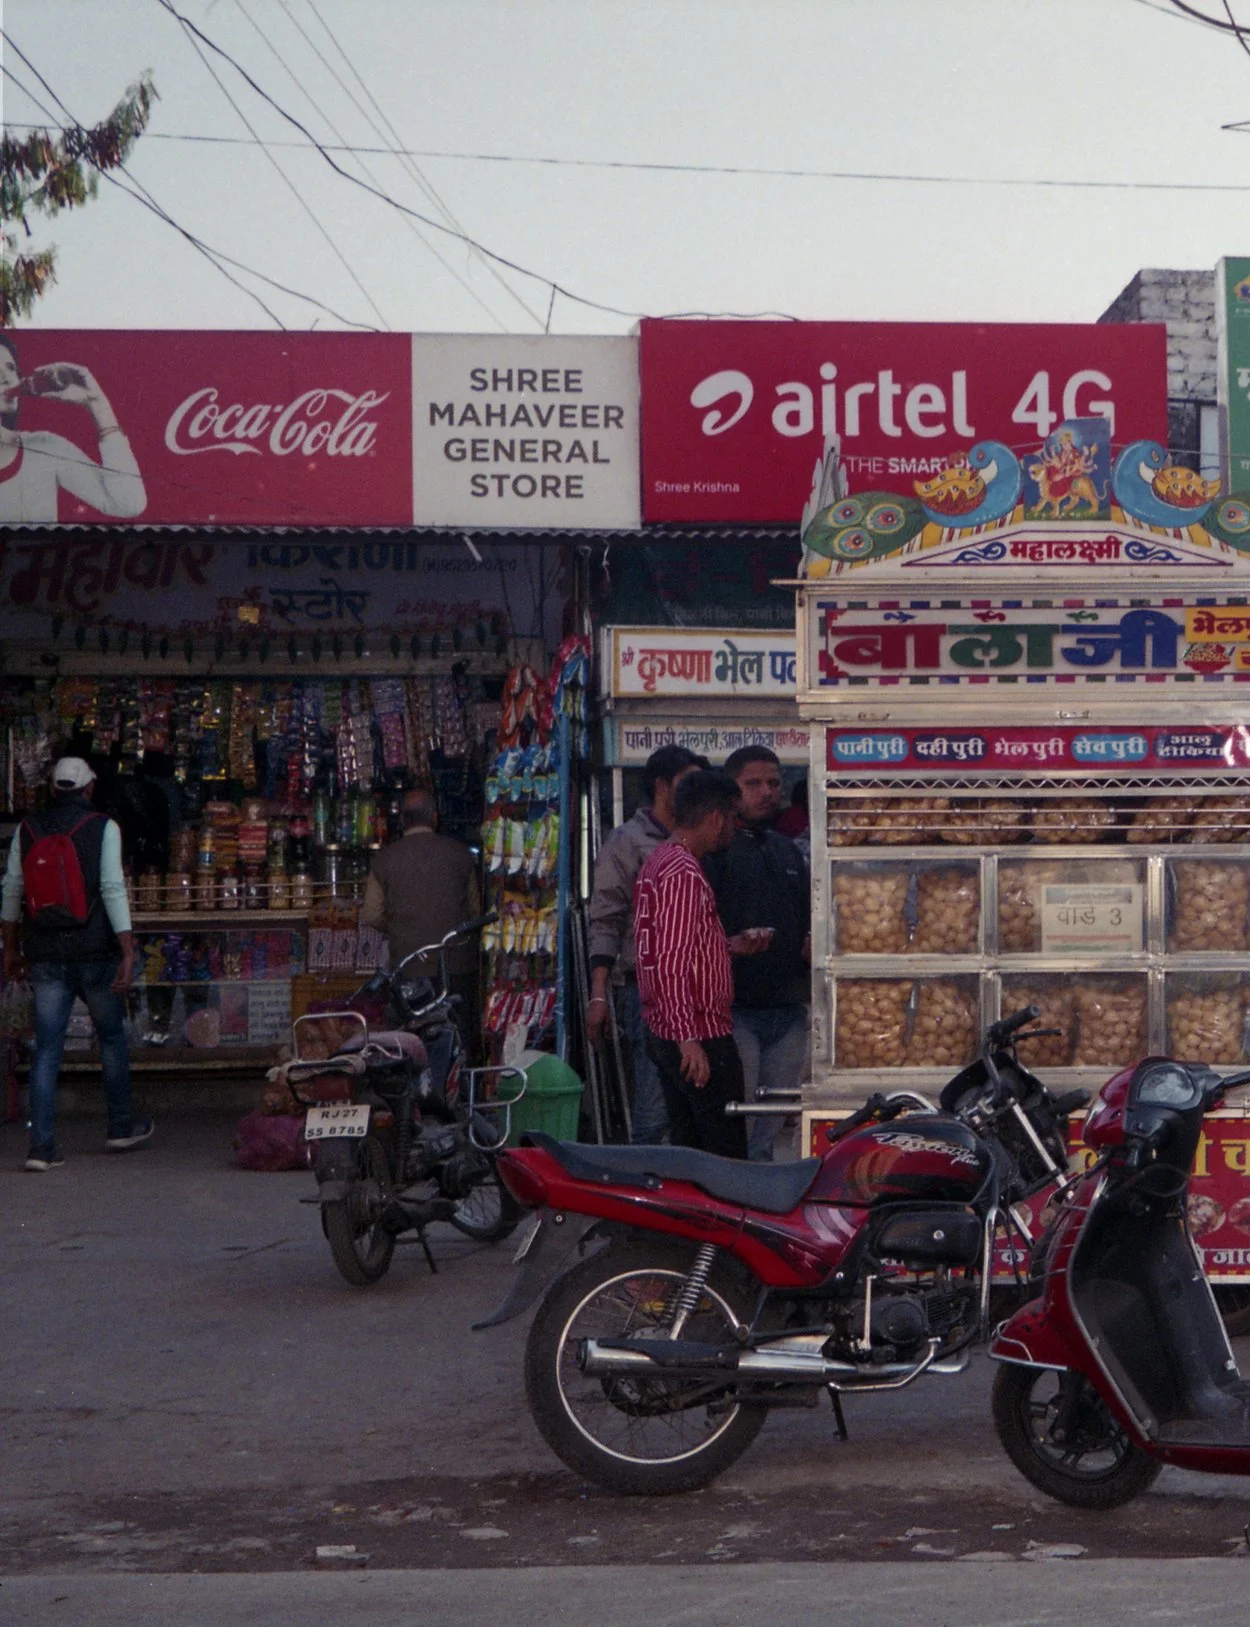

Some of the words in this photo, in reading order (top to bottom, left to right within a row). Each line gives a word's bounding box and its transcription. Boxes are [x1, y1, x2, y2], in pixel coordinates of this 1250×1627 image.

[469, 368, 584, 394] SHREE
[771, 361, 975, 438] airtel
[1011, 369, 1116, 437] 4G
[164, 386, 391, 457] Coca-Cola
[429, 402, 625, 430] MAHAVEER
[444, 438, 611, 466] GENERAL
[846, 457, 884, 474] THE
[470, 473, 585, 500] STORE
[654, 480, 690, 494] Shree
[694, 480, 740, 494] Krishna
[1008, 534, 1122, 562] महालक्ष्मी
[637, 648, 713, 692] कृष्णा
[714, 638, 766, 685] भेल
[836, 737, 873, 755] पानी
[876, 737, 906, 759] पुरी
[915, 737, 950, 756] दही
[951, 737, 985, 760] पुरी
[994, 737, 1029, 756] भेल
[1032, 737, 1066, 760] पुरी
[1073, 736, 1107, 754] सेव
[1110, 736, 1145, 759] पुरी
[1109, 906, 1123, 926] 3
